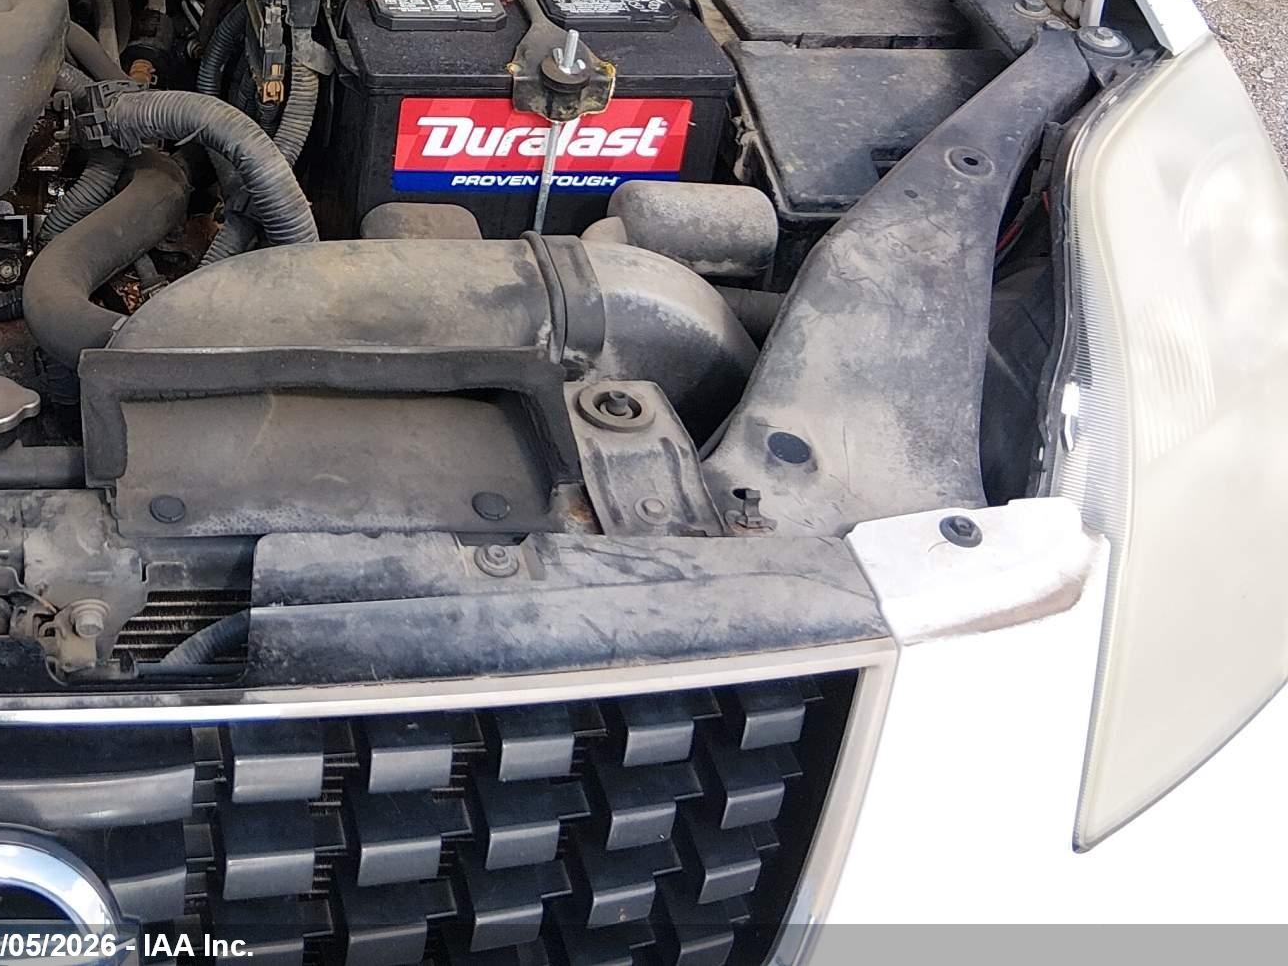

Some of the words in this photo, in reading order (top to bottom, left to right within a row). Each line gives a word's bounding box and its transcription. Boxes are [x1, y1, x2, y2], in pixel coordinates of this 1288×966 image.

[416, 116, 669, 157] Duralast
[451, 175, 539, 186] PROVEN
[549, 175, 616, 186] TOUGH
